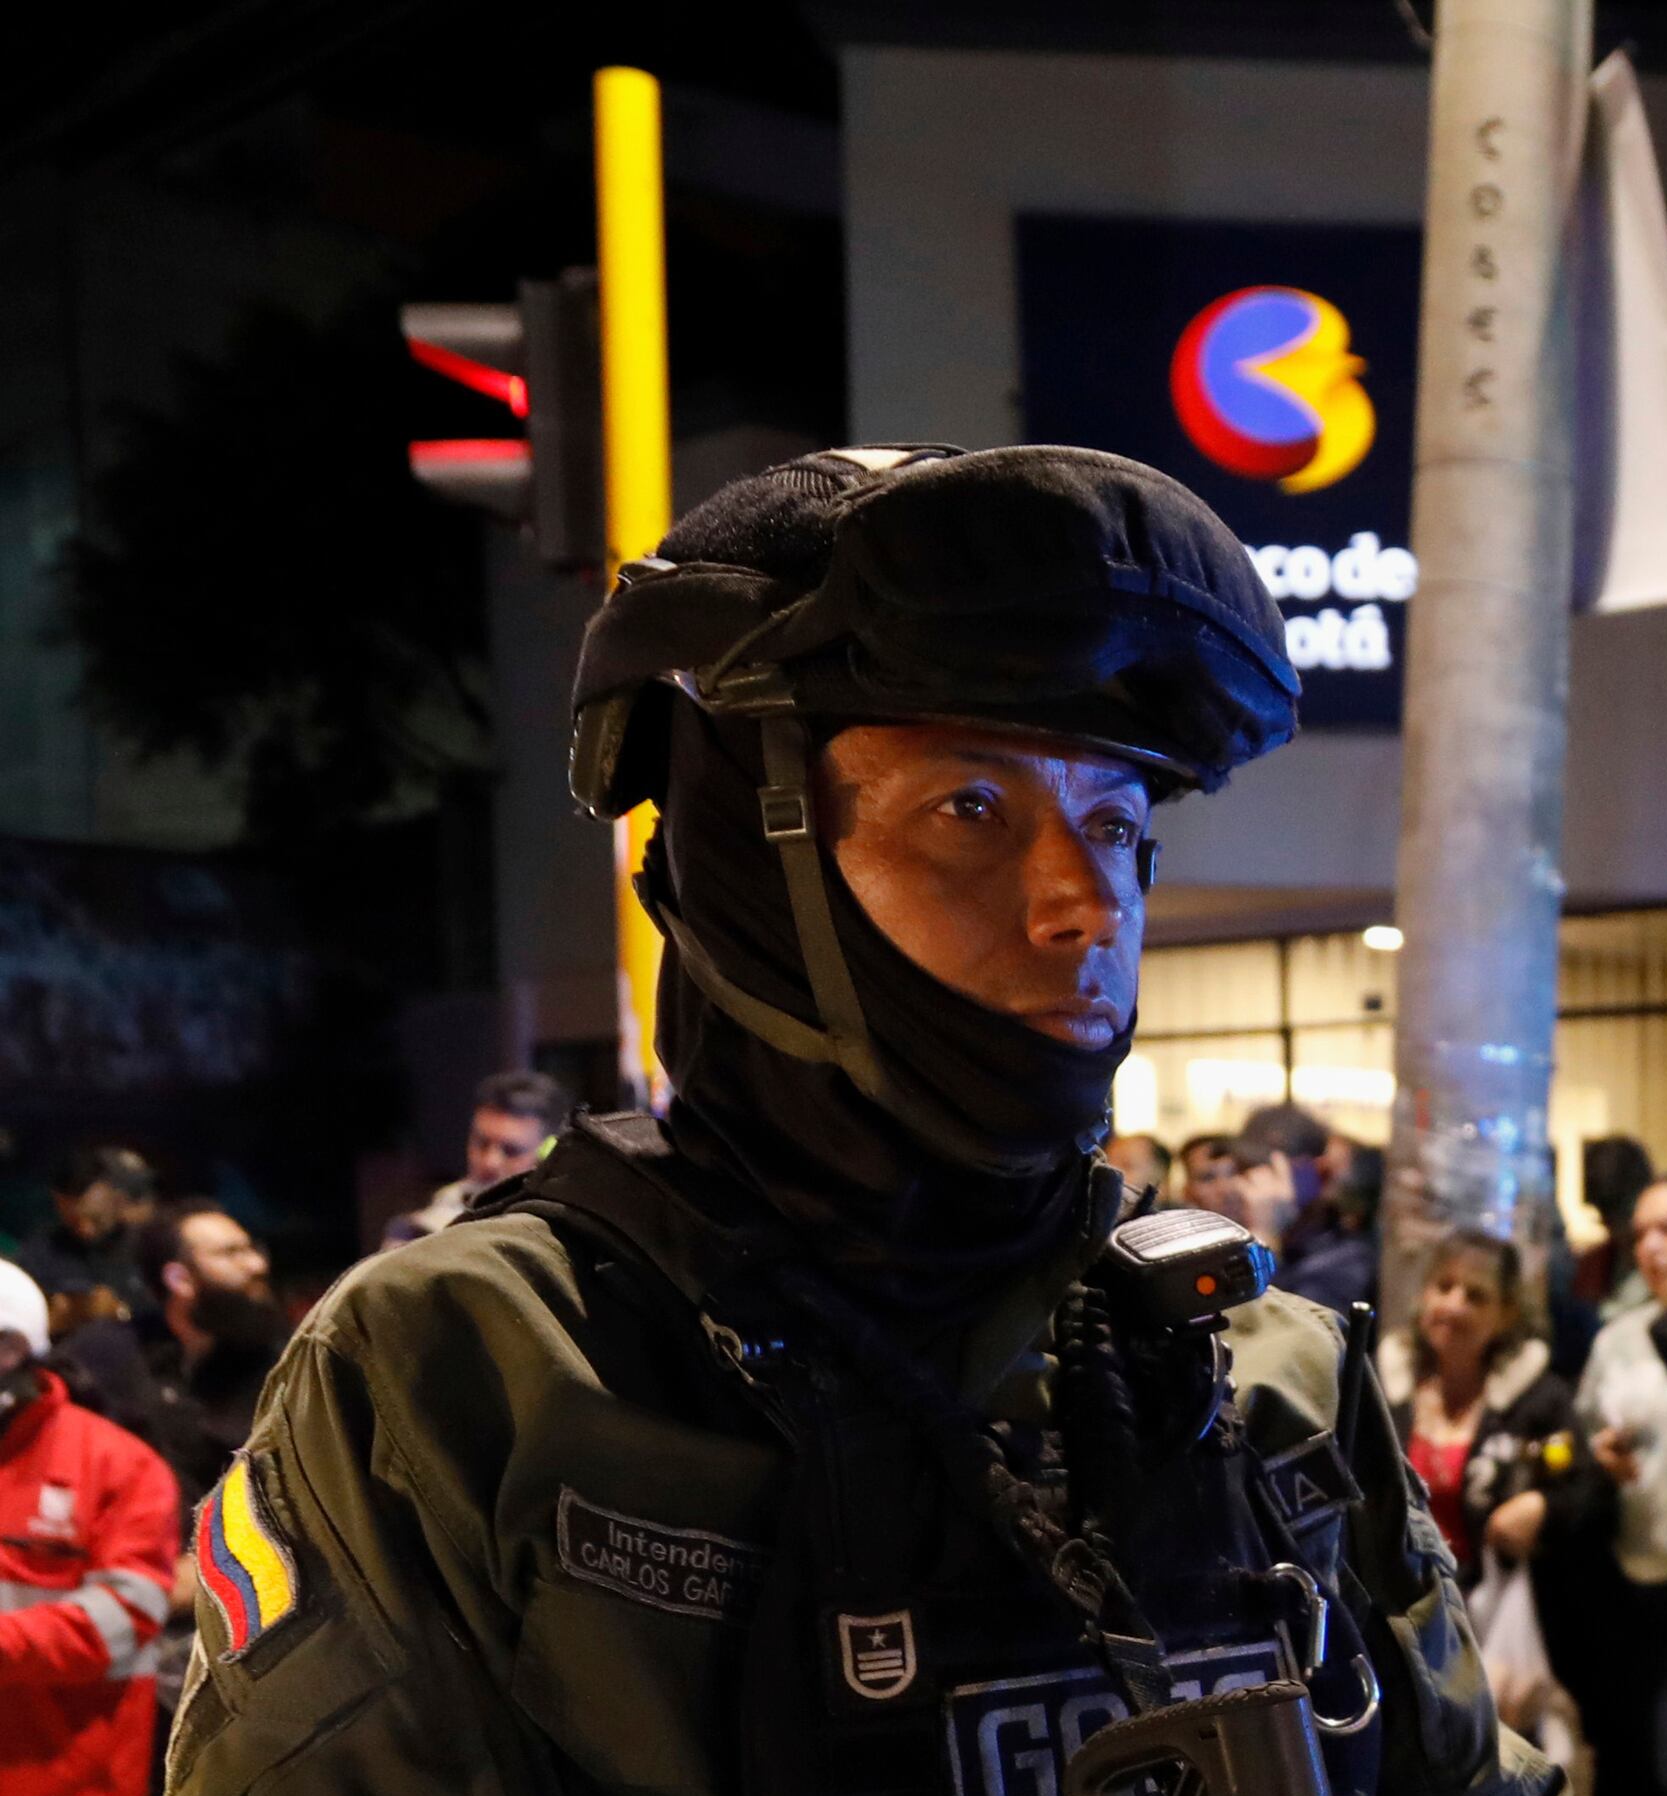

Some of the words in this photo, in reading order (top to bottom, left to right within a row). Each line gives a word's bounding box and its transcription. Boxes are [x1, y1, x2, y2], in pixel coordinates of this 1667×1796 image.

[1332, 531, 1418, 601] de
[1285, 603, 1393, 670] otá
[580, 1541, 671, 1597] CARLOS
